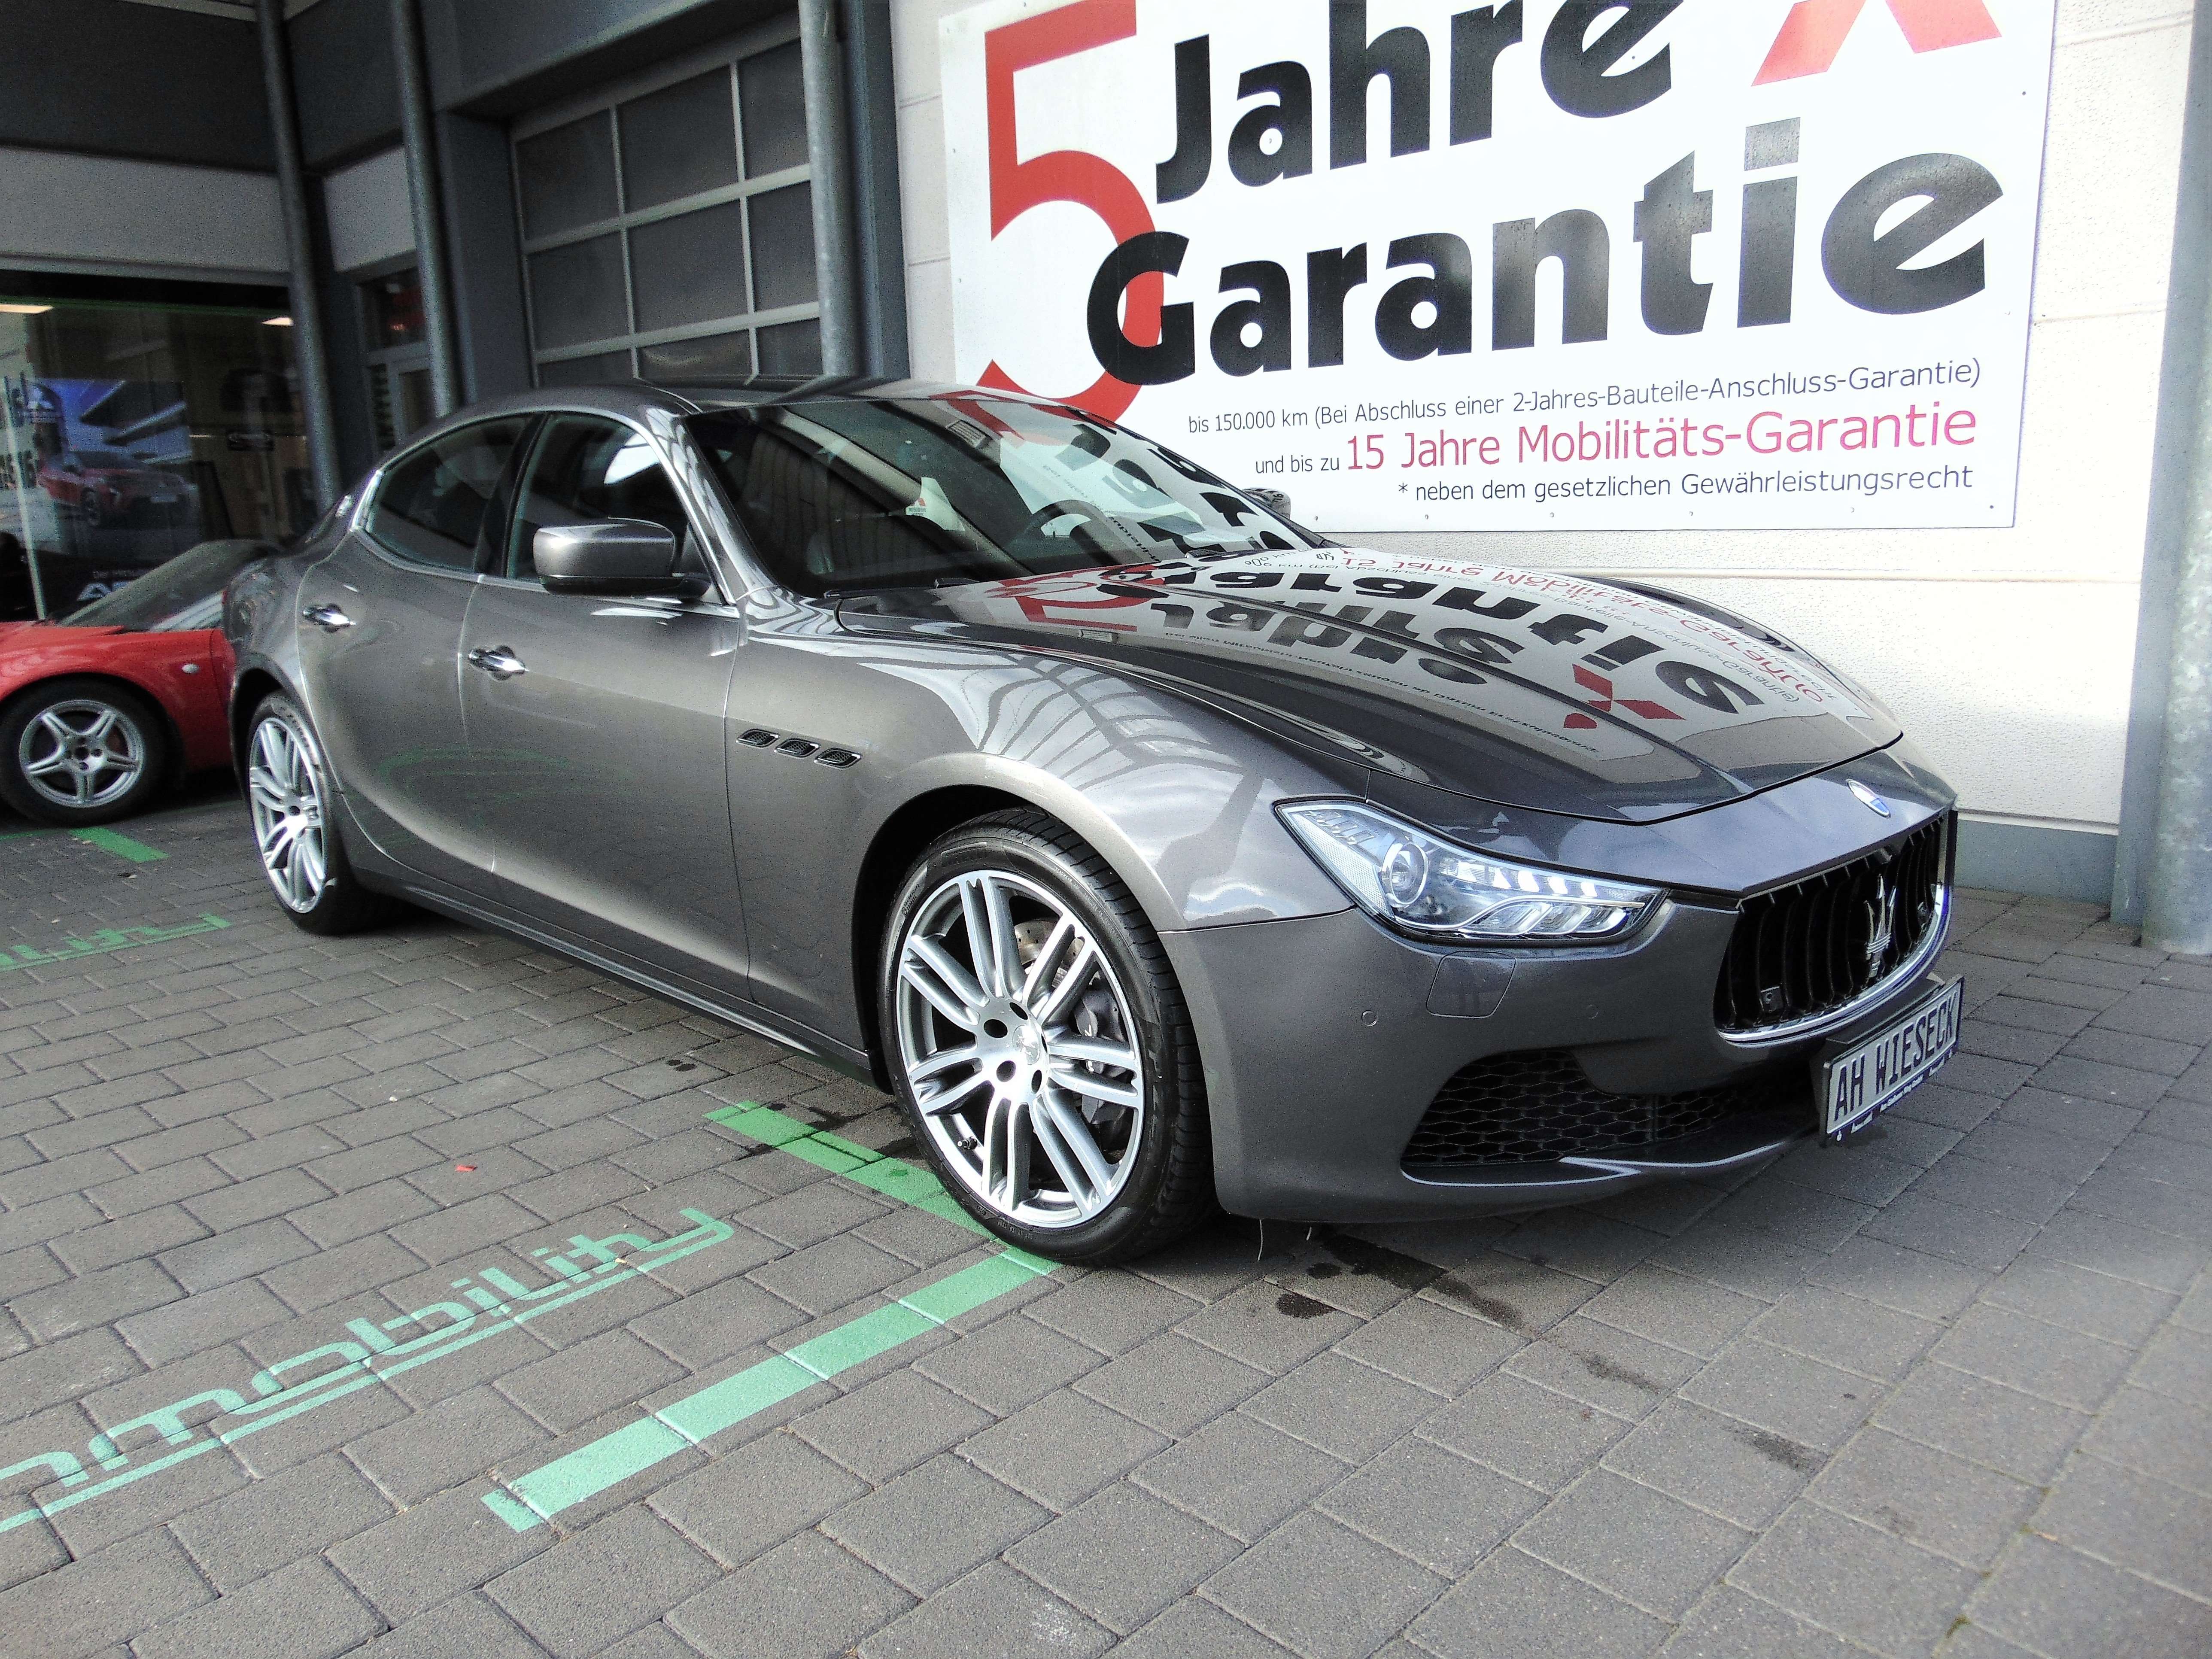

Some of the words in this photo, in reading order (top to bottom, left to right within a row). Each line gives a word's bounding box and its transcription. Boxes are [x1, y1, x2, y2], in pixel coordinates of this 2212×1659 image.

[976, 0, 1163, 426] 5
[1155, 0, 1683, 204] Jahre
[1087, 117, 2004, 386] Garantie
[1188, 416, 1209, 433] bis
[1215, 410, 1275, 431] 150.000
[1282, 409, 1308, 428] km
[1315, 406, 1347, 429] (Bei
[1355, 399, 1446, 422] Abschluss
[1455, 397, 1504, 415] einer
[1513, 358, 1980, 411] 2-Jahres-Bauteile-Anschluss-Garantie)
[1255, 455, 1284, 474] und
[1290, 454, 1313, 472] bis
[1320, 457, 1340, 471] zu
[1347, 434, 1384, 470] 15
[1401, 429, 1500, 468] Jahre
[1518, 402, 1976, 463] Mobilitäts-Garantie
[1416, 481, 1474, 501] neben
[1482, 479, 1525, 499] dem
[1534, 475, 1671, 503] gesetzlichen
[1681, 465, 1974, 496] Gewährleistungsrecht
[1834, 1054, 1866, 1122] AH
[1875, 991, 1957, 1095] WIESECK
